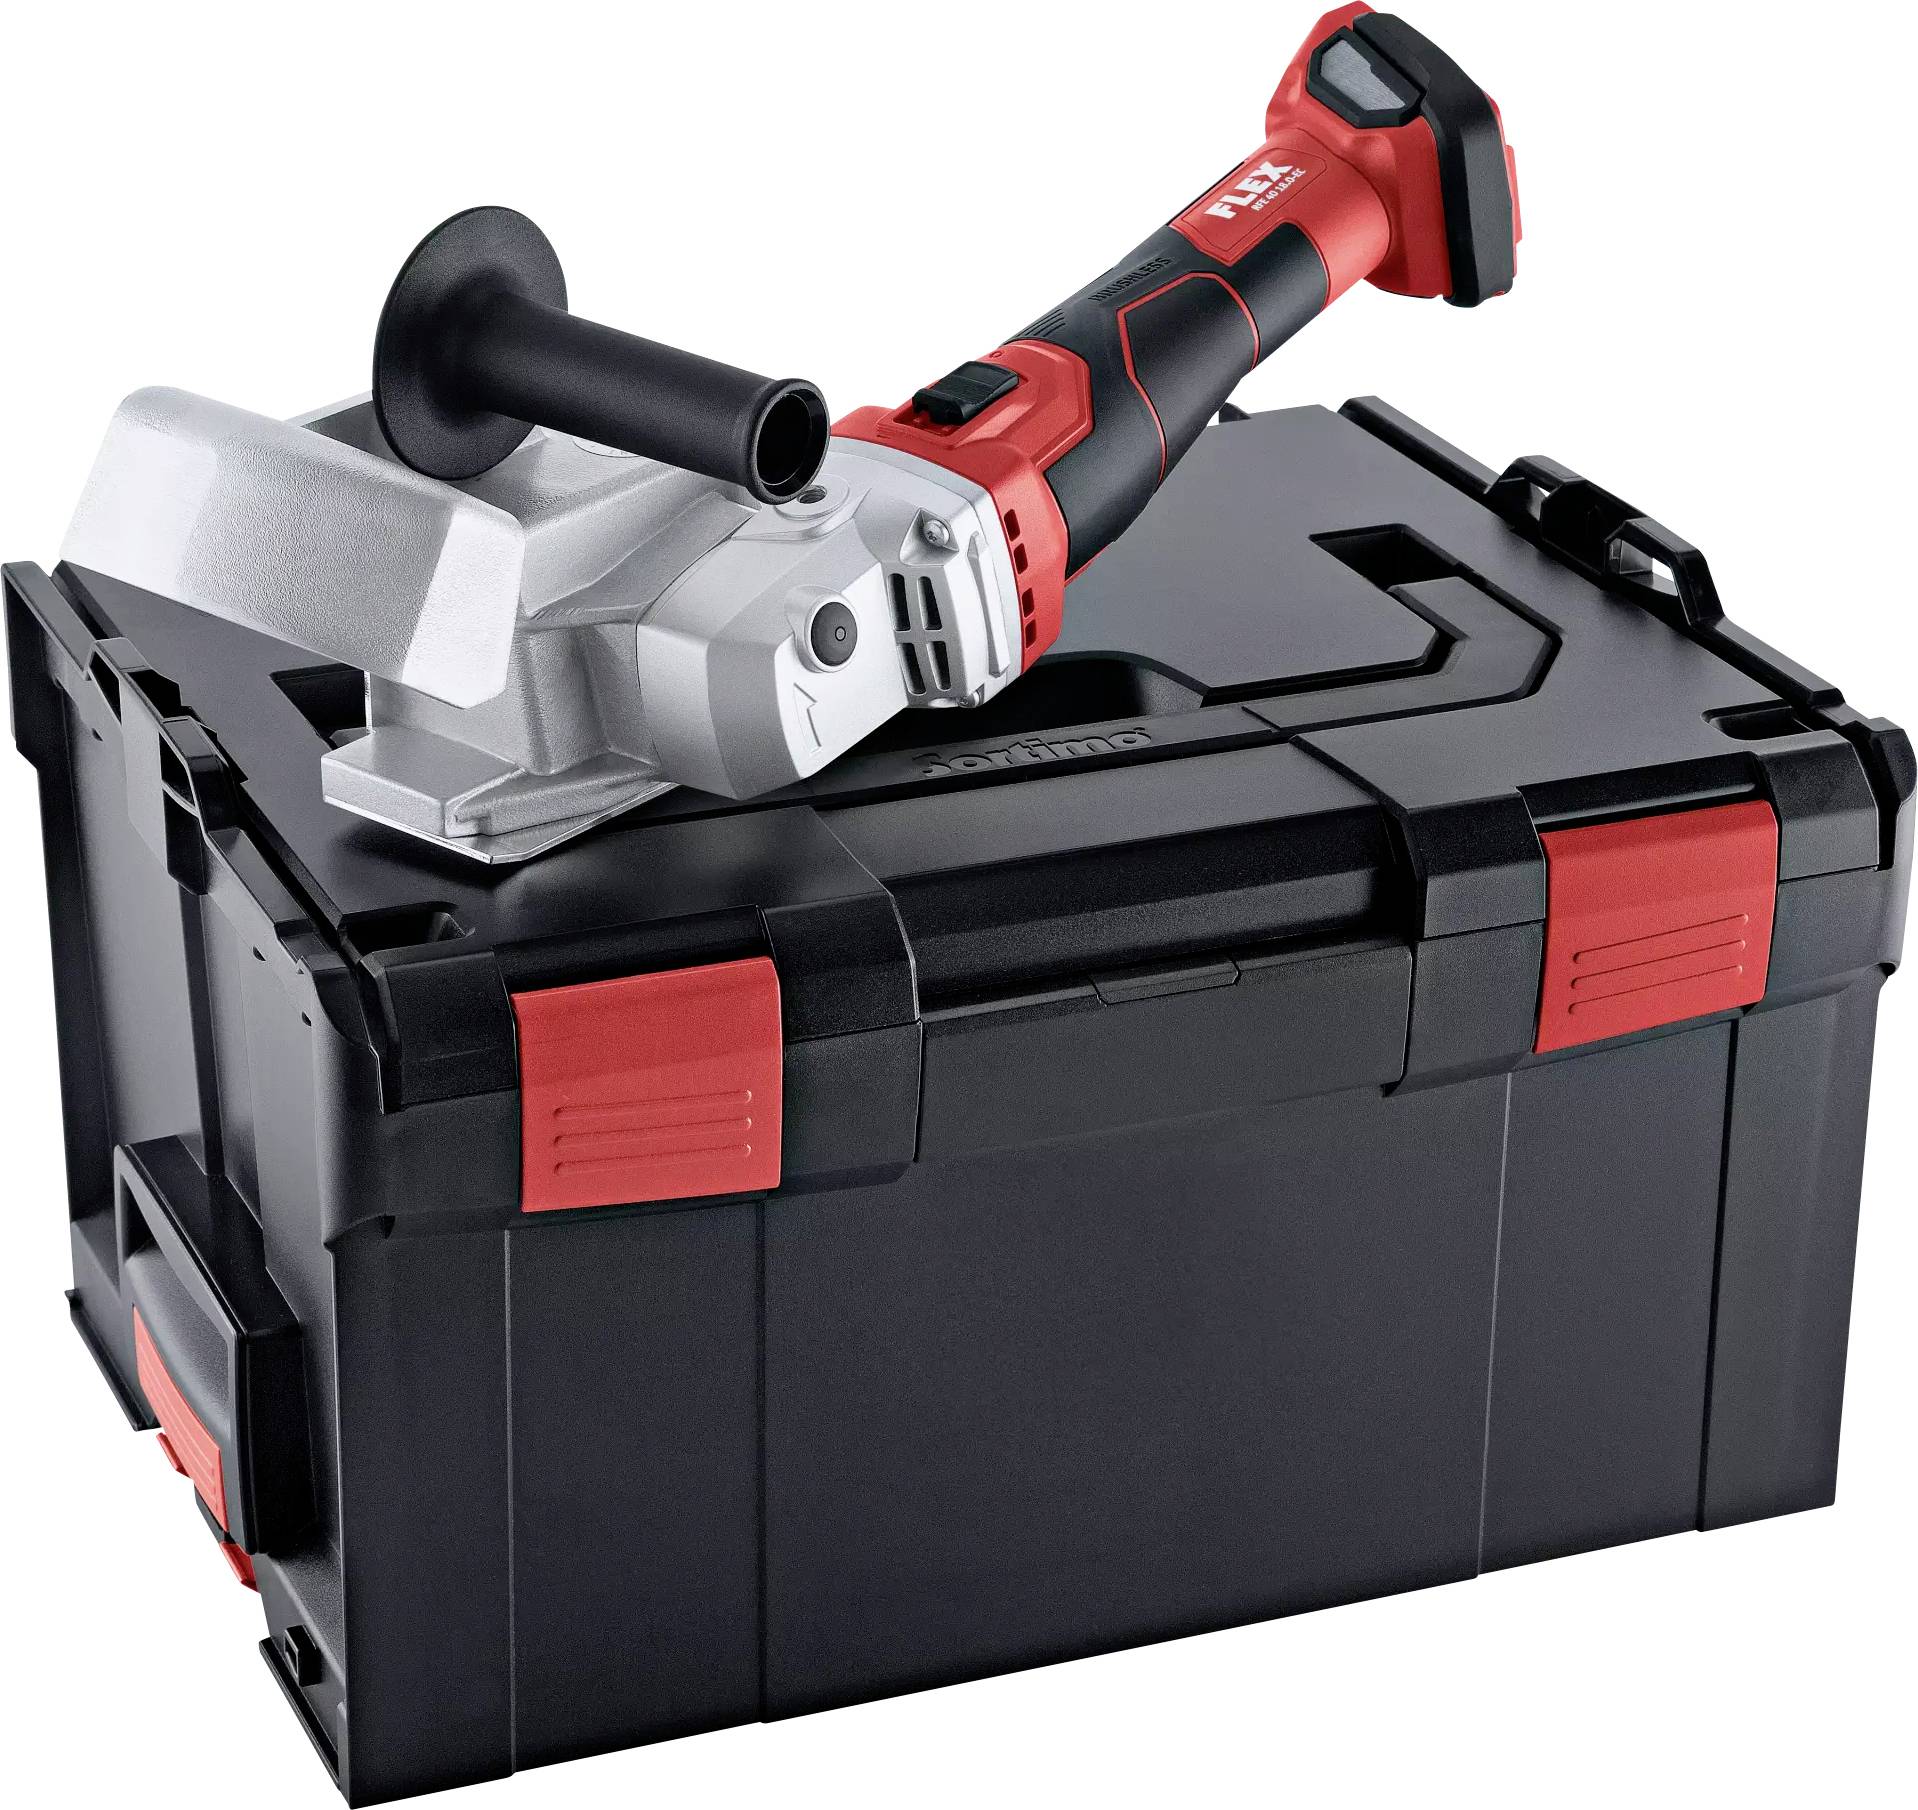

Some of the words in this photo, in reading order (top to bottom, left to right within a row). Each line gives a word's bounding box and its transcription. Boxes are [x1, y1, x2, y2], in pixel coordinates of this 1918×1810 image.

[1204, 160, 1294, 220] FLEX
[1265, 190, 1279, 200] 40
[1274, 167, 1306, 192] 18.0-EC
[1088, 257, 1173, 302] BRUSHLESS
[912, 730, 1151, 777] Sortimo
